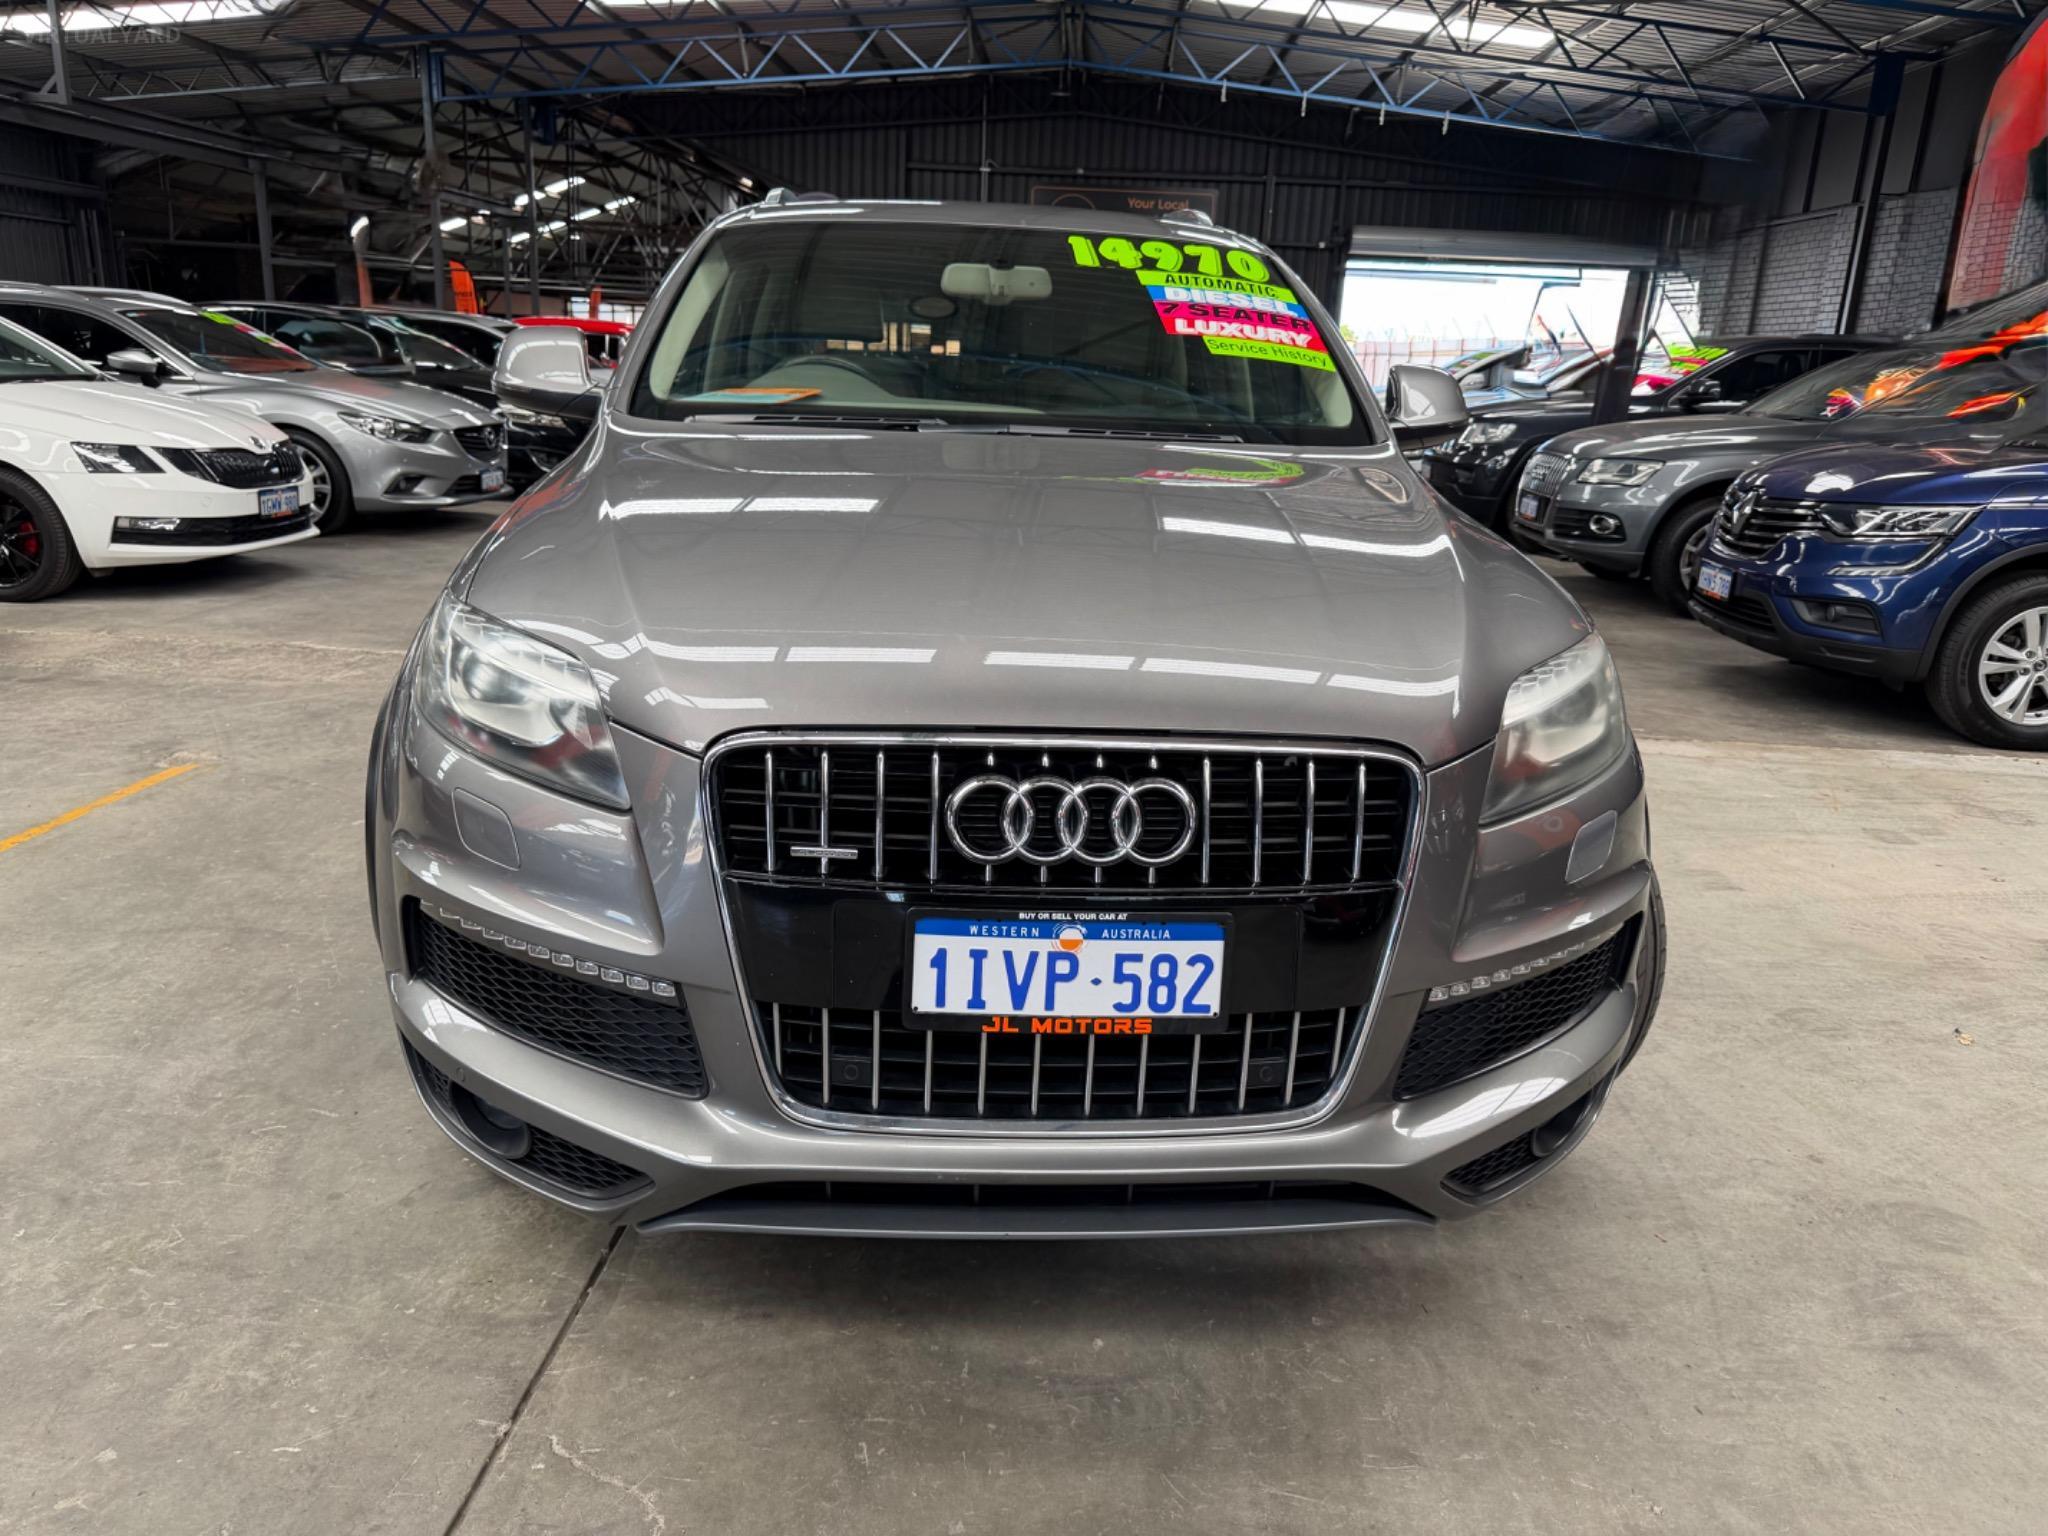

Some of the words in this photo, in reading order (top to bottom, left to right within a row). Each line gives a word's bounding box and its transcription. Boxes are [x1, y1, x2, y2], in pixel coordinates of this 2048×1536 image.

[1127, 198, 1154, 209] Your
[1158, 199, 1190, 210] Local
[1068, 235, 1270, 282] 14970
[1165, 274, 1276, 297] AUTOMATIC
[1164, 286, 1299, 317] DIESEL
[1162, 303, 1179, 315] 7
[1189, 303, 1311, 331] SEATER
[1175, 318, 1313, 347] LUXURY
[1206, 339, 1268, 355] Service
[1274, 346, 1327, 367] History
[1019, 912, 1036, 920] BUY
[1038, 912, 1050, 920] OR
[1052, 912, 1072, 920] SELL
[1074, 912, 1097, 920] YOUR
[1098, 912, 1115, 920] CAR
[1117, 912, 1128, 920] AT
[969, 925, 1040, 937] WESTERN
[1102, 928, 1171, 940] AUSTRALIA
[982, 1016, 1019, 1033] JL
[1031, 1017, 1153, 1034] MOTORS
